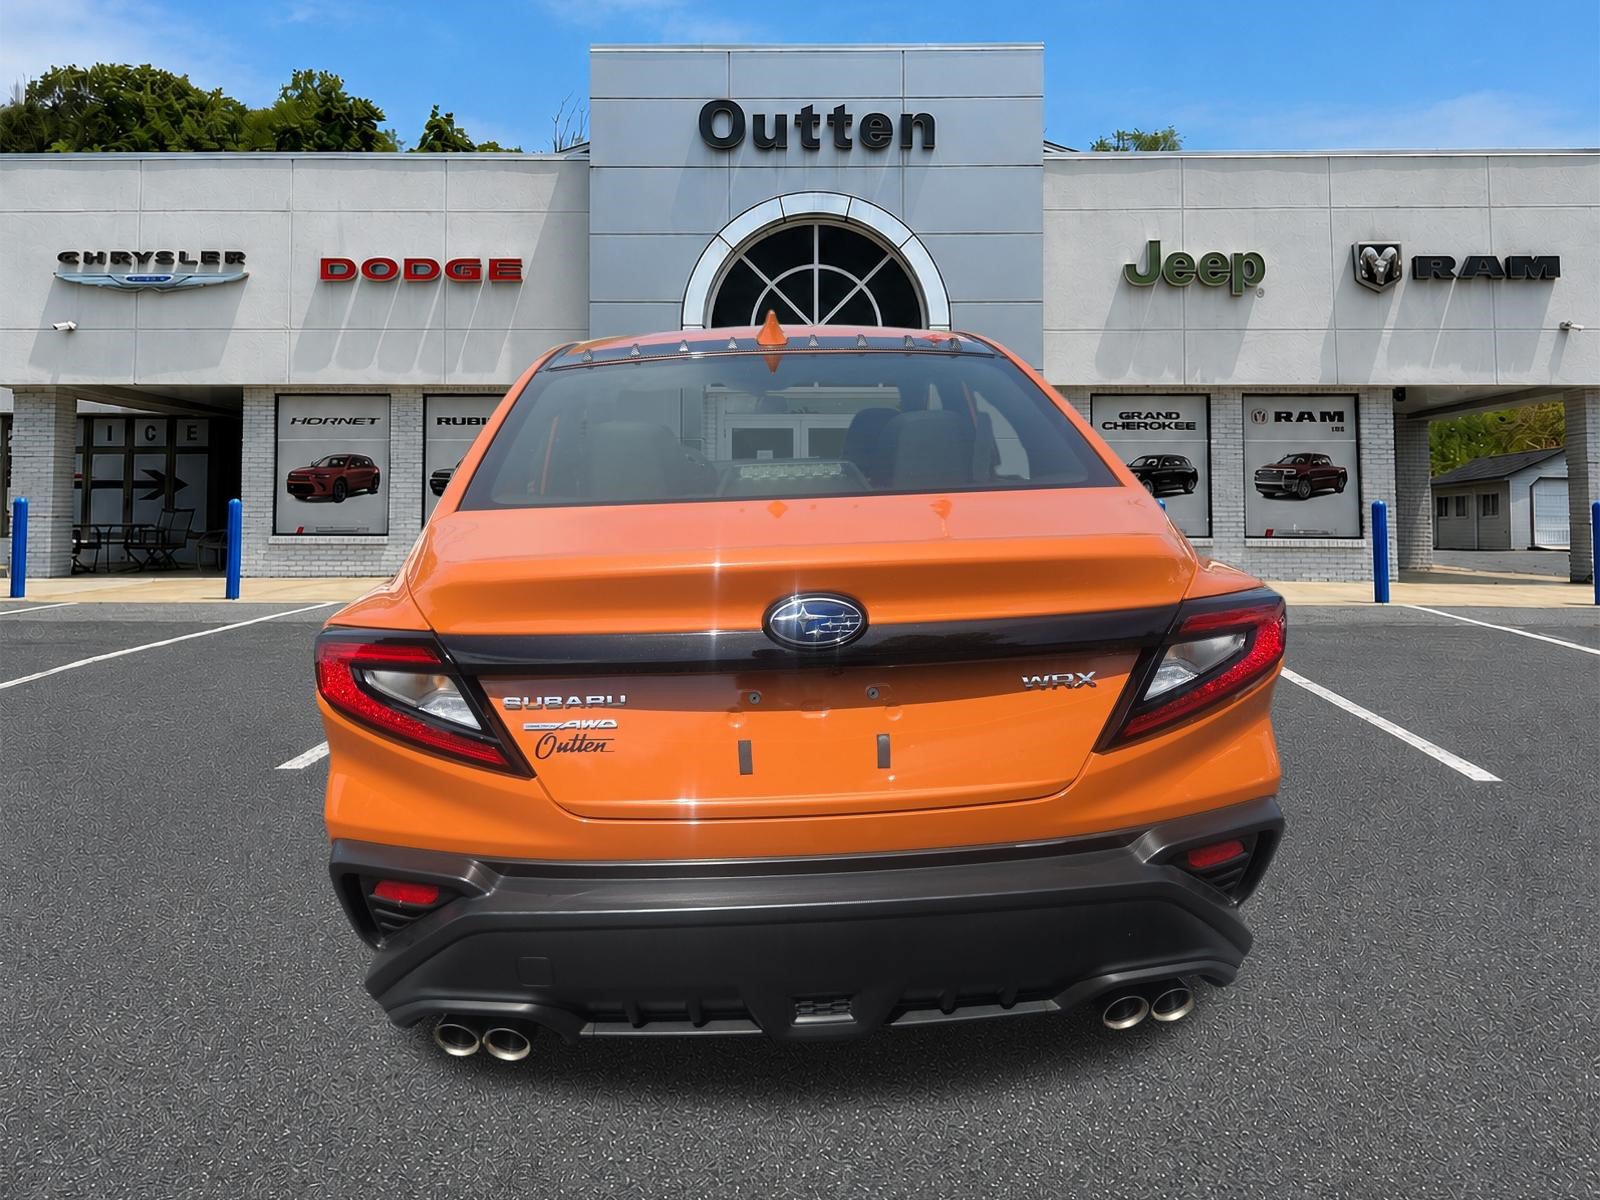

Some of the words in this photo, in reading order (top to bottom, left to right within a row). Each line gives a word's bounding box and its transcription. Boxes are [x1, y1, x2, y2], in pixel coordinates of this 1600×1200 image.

[699, 99, 936, 150] Outten
[57, 250, 247, 265] CHRYSLER
[320, 257, 523, 283] DODGE
[1124, 240, 1266, 297] Jeep
[1411, 255, 1560, 280] RAM
[290, 417, 380, 426] HORNET
[436, 417, 490, 426] RUBI
[1118, 411, 1181, 420] GRAND
[1274, 411, 1345, 423] RAM
[1101, 421, 1197, 431] CHEROKEE
[1022, 671, 1097, 690] WRX
[503, 695, 627, 710] SUBARU
[560, 719, 618, 730] AWD
[534, 731, 616, 760] Outten
